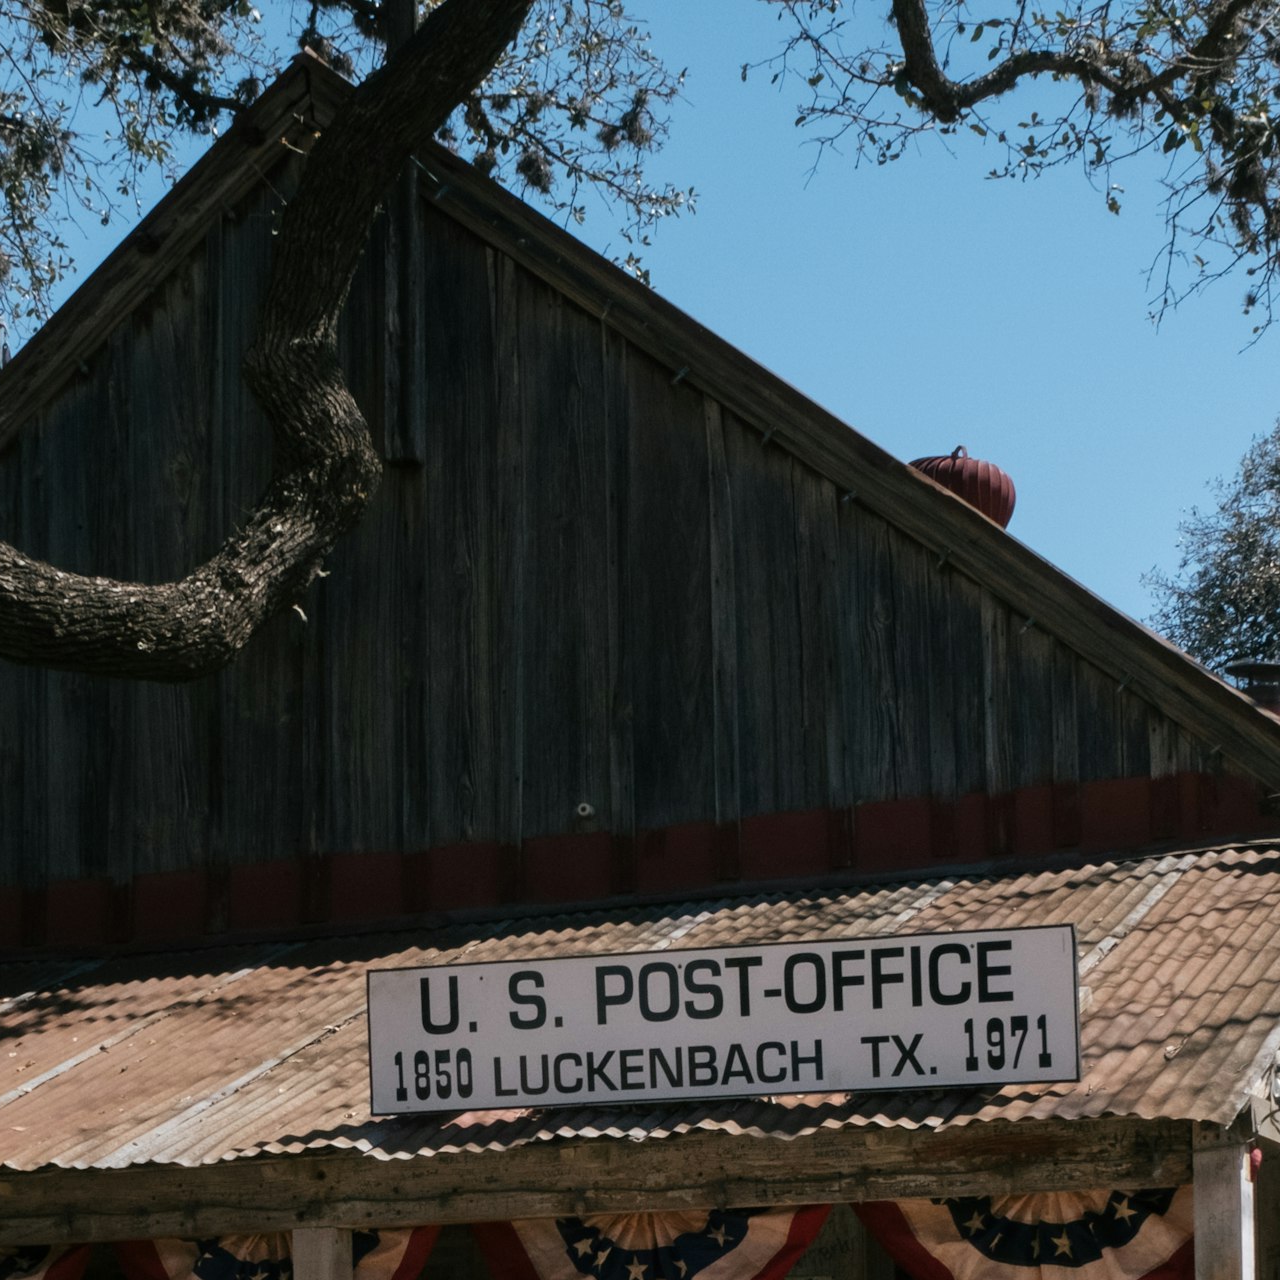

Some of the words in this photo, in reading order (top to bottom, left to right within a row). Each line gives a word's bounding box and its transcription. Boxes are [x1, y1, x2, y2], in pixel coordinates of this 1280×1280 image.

[418, 973, 480, 1036] U.
[507, 969, 565, 1031] S.
[595, 940, 1016, 1026] POST-OFFICE
[393, 1047, 474, 1102] 1850
[492, 1039, 825, 1097] LUCKENBACH
[861, 1032, 938, 1079] TX.
[963, 1013, 1053, 1073] 1971
